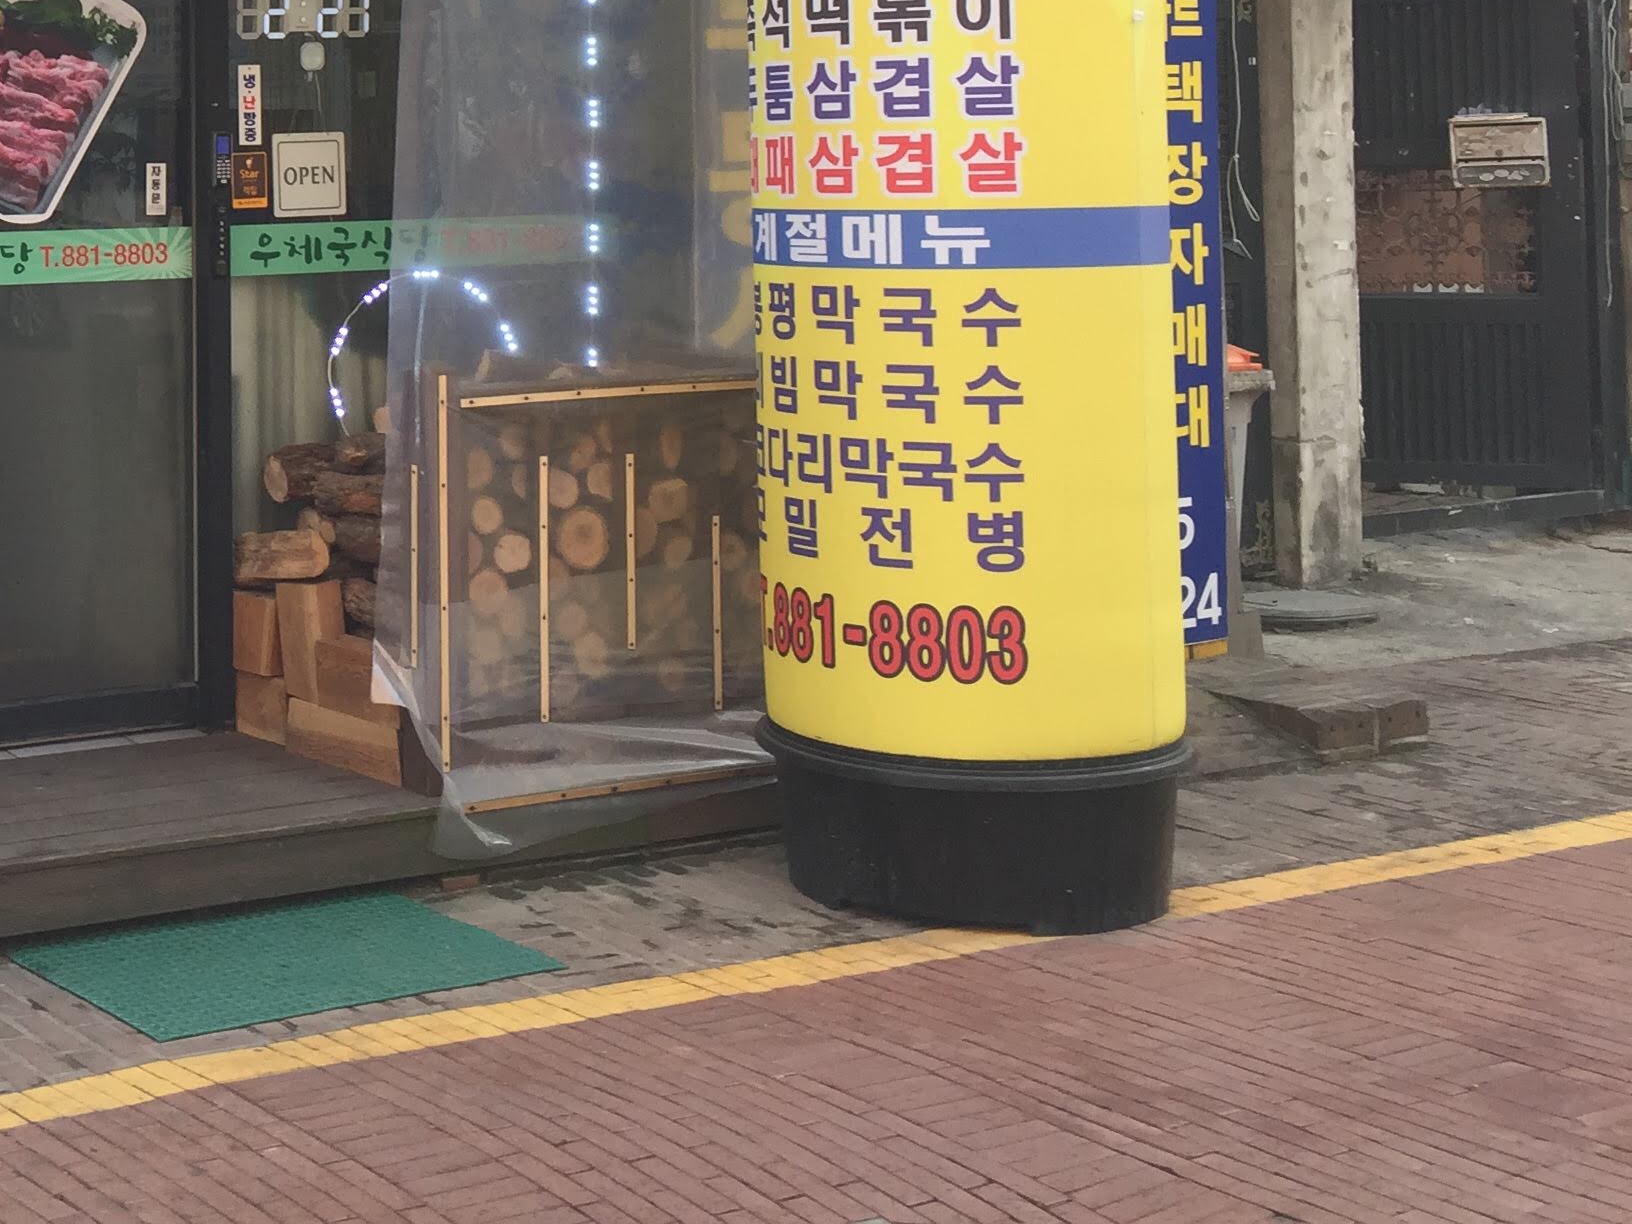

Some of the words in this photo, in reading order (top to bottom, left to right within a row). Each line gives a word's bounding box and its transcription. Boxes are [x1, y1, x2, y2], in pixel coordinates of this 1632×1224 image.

[283, 165, 335, 186] OPEN
[39, 243, 169, 269] T.881-8803
[754, 212, 991, 266] 계절메뉴
[756, 351, 1024, 425] 빔막국수
